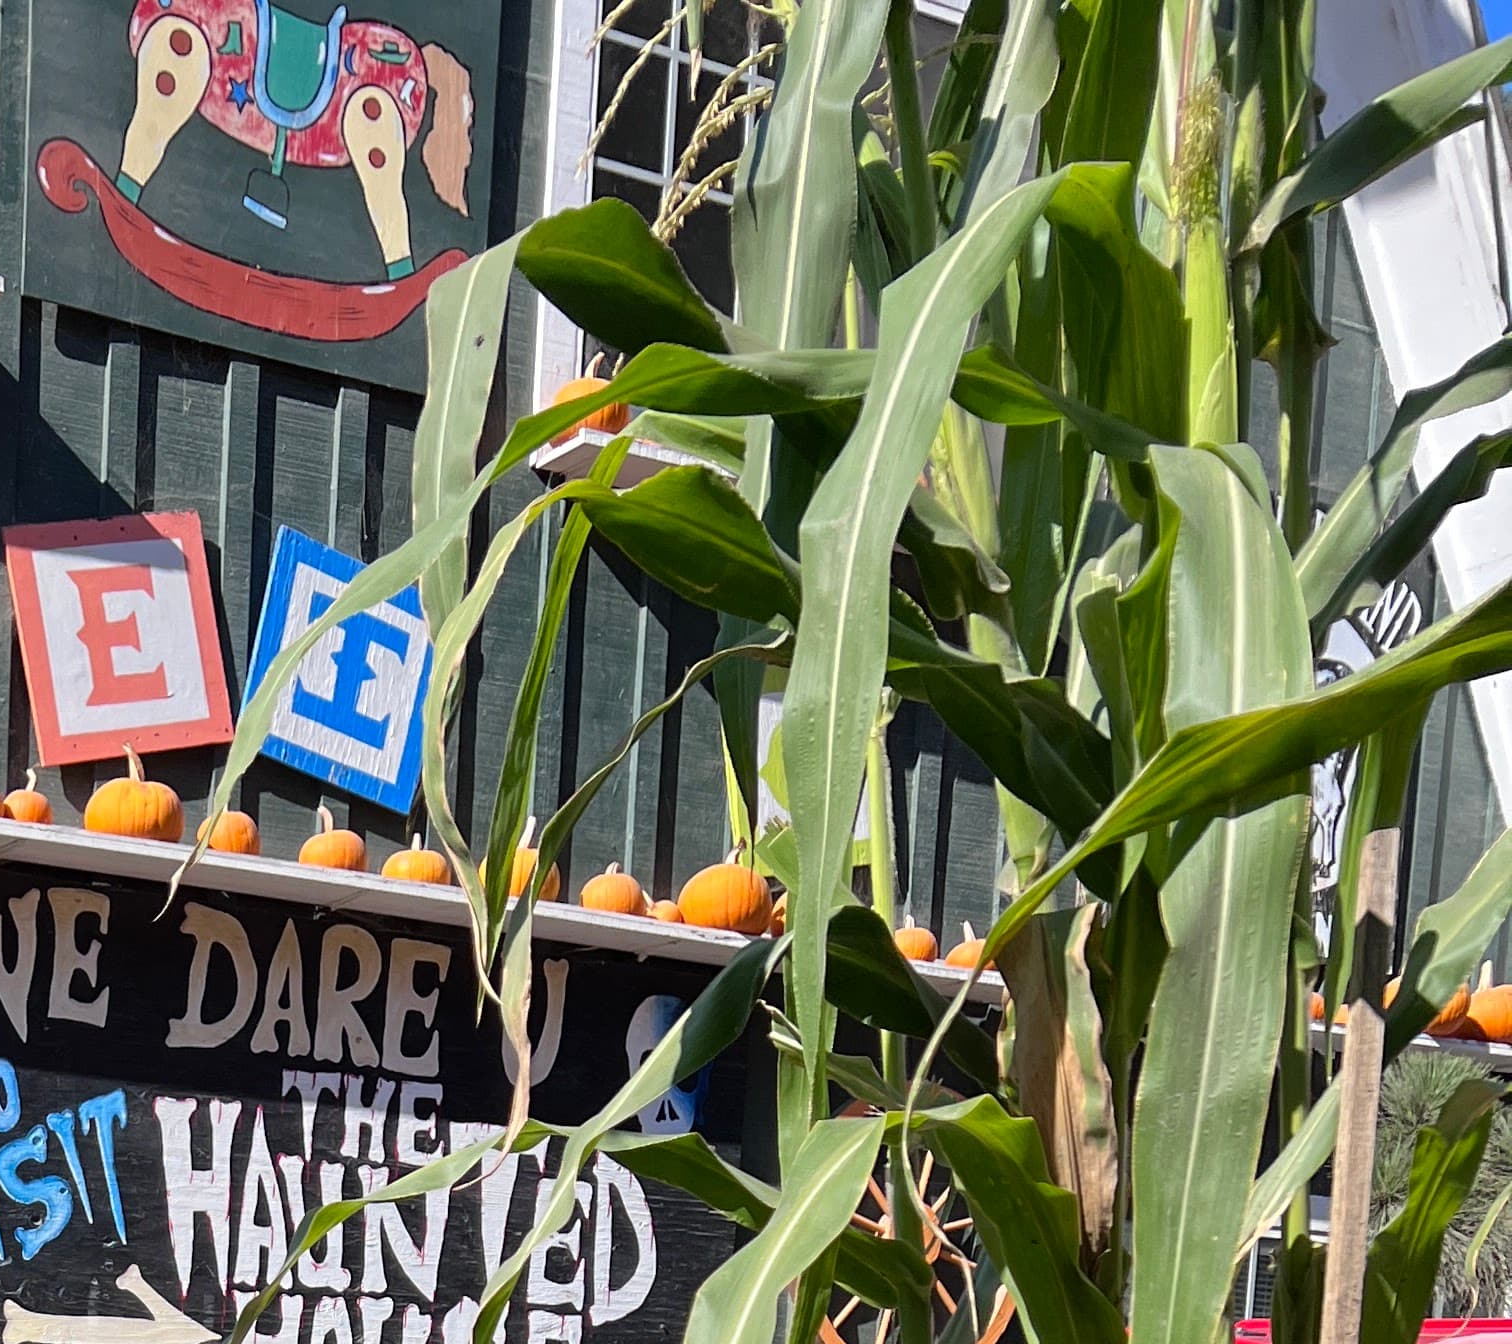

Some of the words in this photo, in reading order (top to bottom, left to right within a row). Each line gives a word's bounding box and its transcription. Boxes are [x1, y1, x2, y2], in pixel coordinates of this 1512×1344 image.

[65, 562, 175, 708] E
[164, 901, 453, 1078] DARE
[280, 1069, 446, 1167] THE
[153, 1096, 658, 1327] HAUNTED
